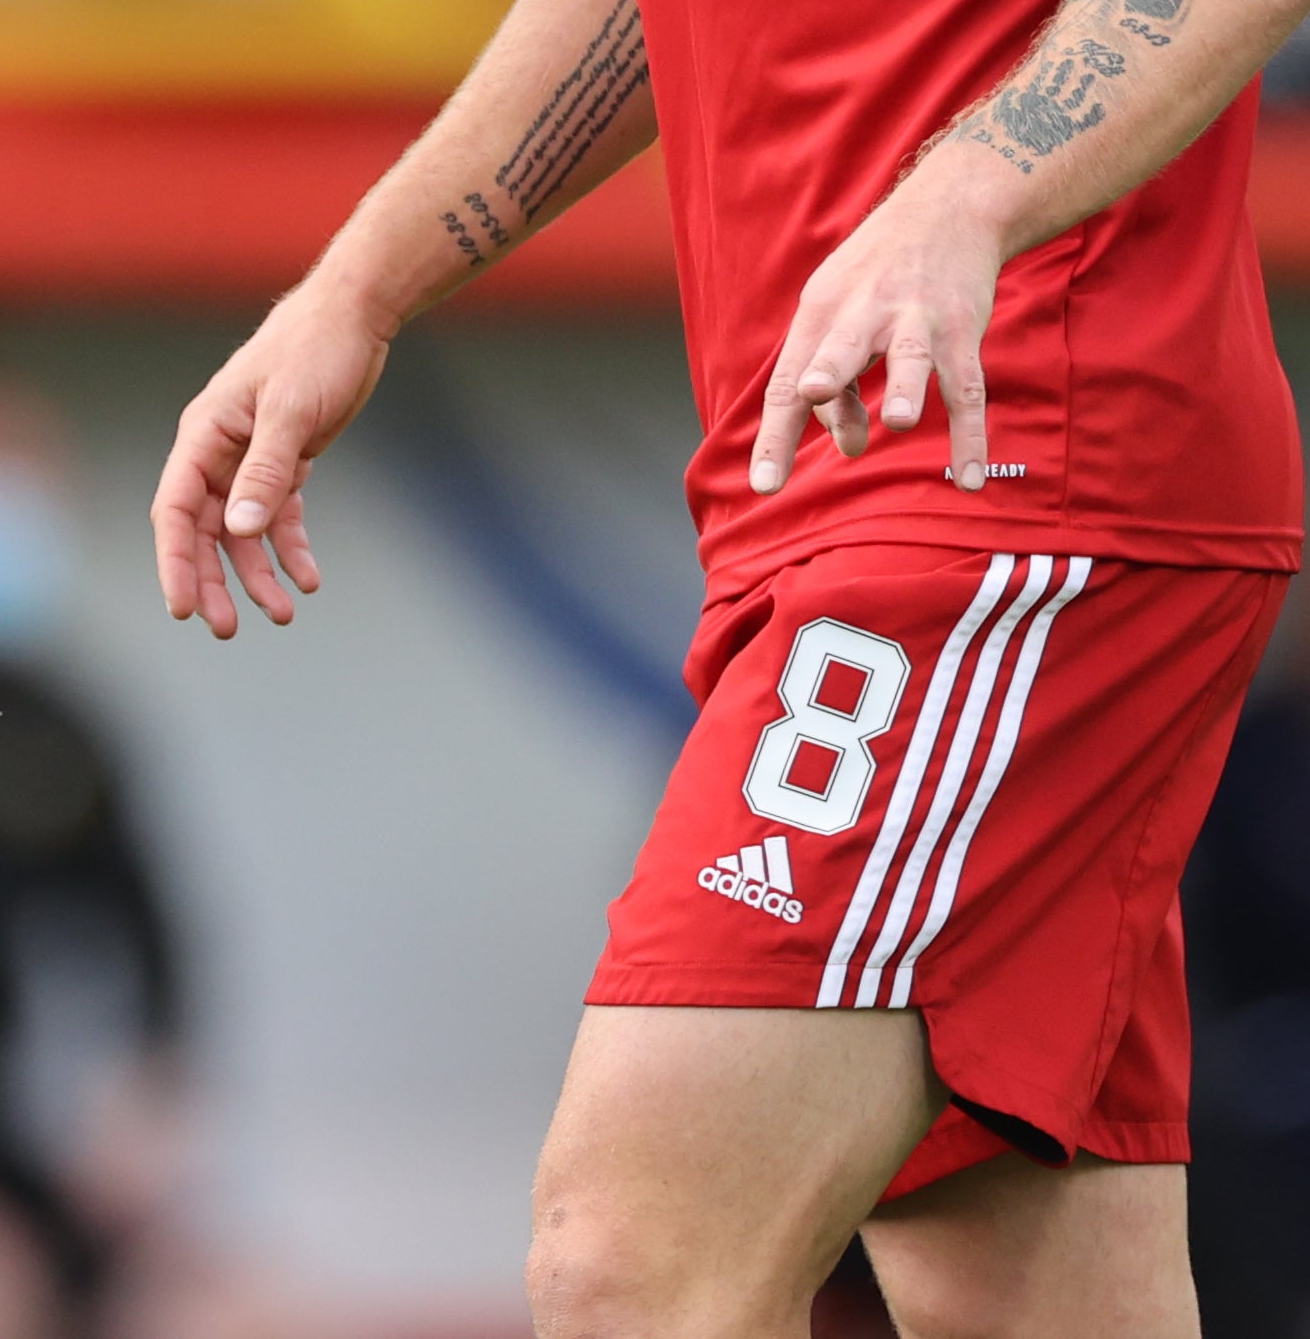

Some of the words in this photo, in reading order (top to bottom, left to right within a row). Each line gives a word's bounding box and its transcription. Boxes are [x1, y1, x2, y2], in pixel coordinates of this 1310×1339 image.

[944, 463, 1026, 480] AREADY
[741, 616, 912, 836] 8
[697, 864, 804, 924] adidas
